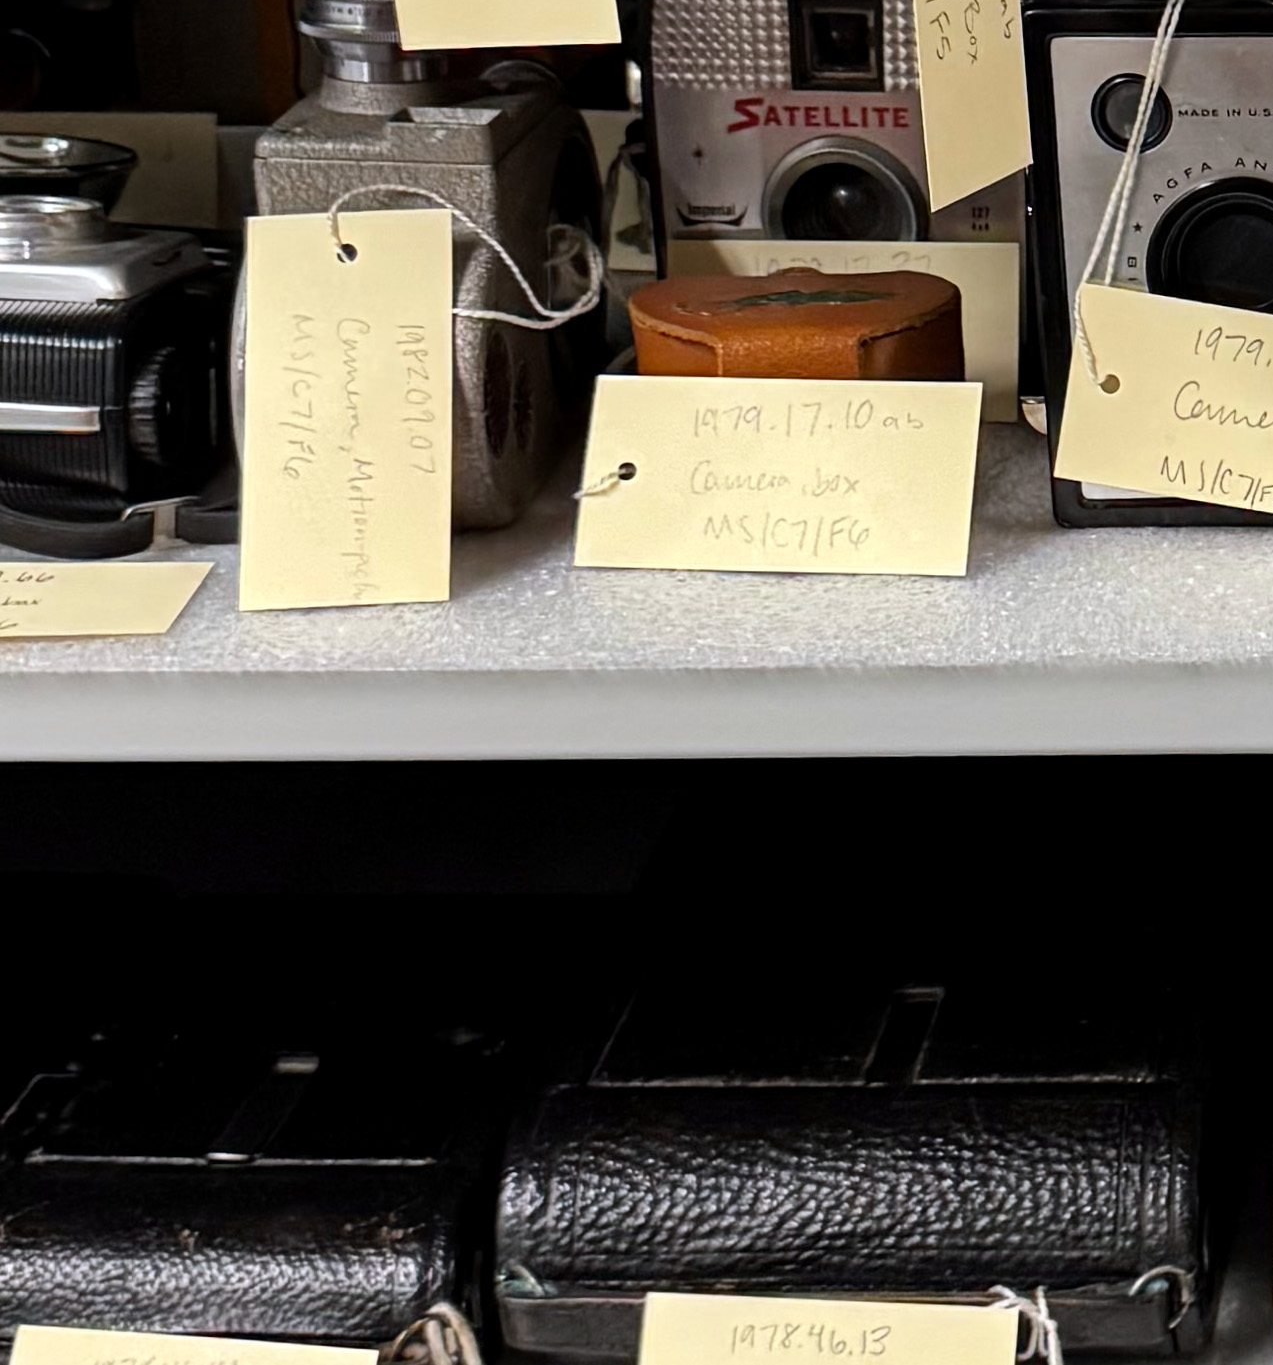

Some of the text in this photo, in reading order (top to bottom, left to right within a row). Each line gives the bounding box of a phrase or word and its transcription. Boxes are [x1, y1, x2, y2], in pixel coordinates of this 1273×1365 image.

[727, 97, 909, 134] SATELLITE
[1178, 107, 1220, 119] MADE
[1226, 107, 1244, 118] IN
[1152, 161, 1213, 205] AGFA
[732, 1324, 892, 1356] 1978.46.13
